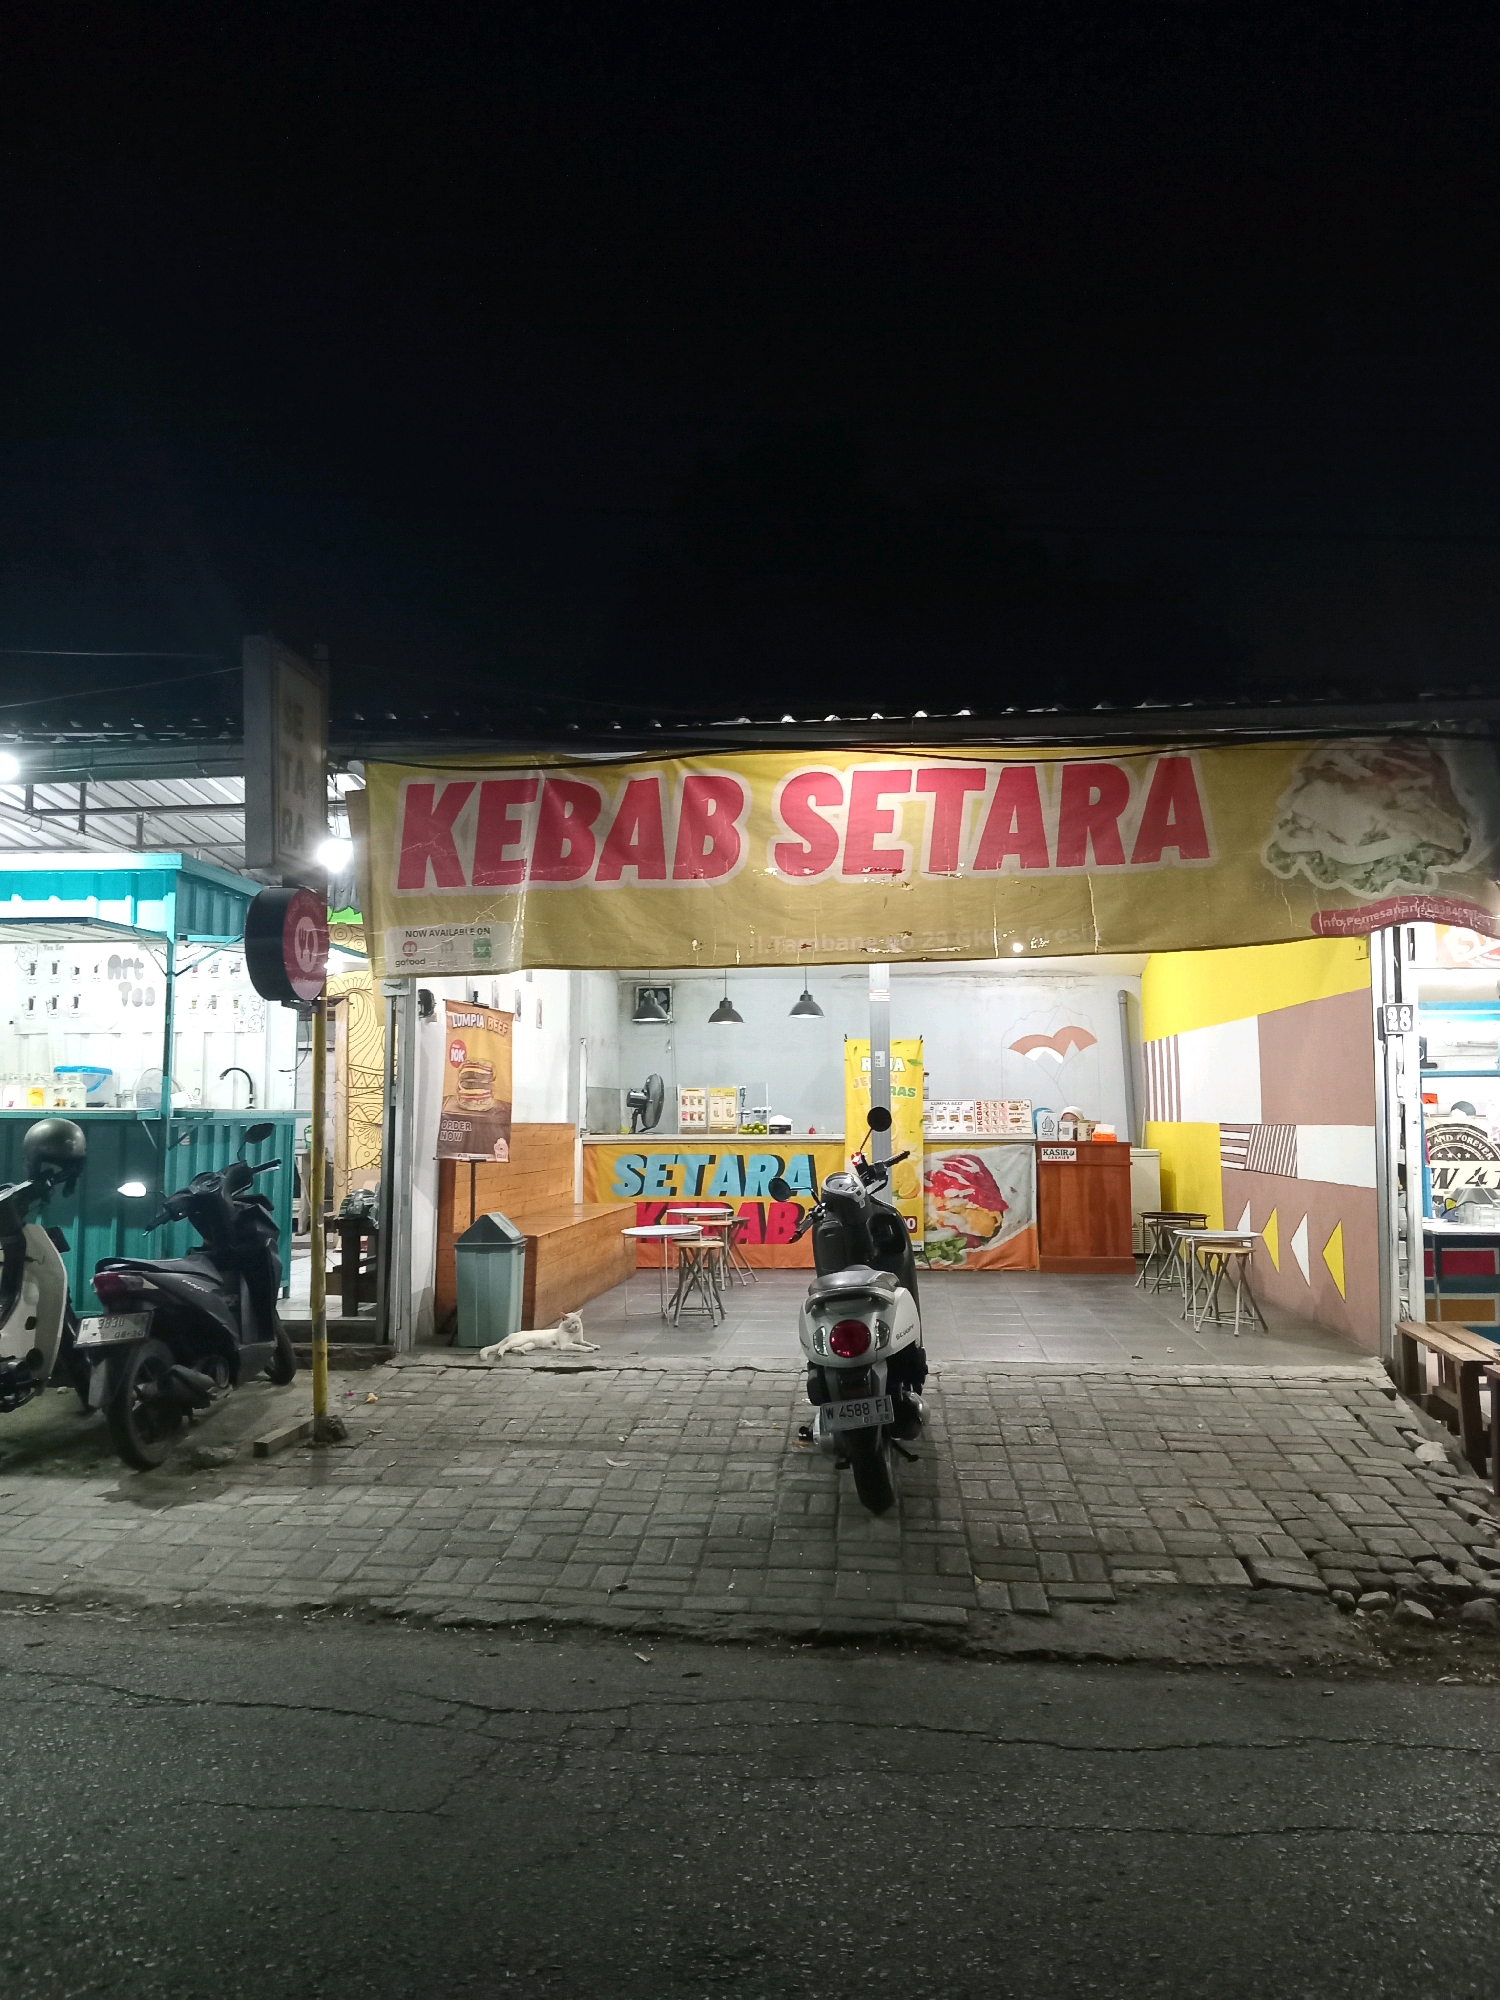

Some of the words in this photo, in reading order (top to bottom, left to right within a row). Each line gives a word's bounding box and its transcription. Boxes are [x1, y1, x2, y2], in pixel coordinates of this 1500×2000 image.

[397, 775, 745, 890] KEBAB
[774, 757, 1211, 876] SETARA
[405, 929, 428, 938] NOW
[477, 926, 491, 935] ON
[452, 1013, 485, 1029] LUMPIA
[487, 1016, 509, 1037] BEEF
[450, 1049, 466, 1062] 10K
[441, 1120, 472, 1131] ORDER
[440, 1131, 463, 1142] NOW
[611, 1154, 816, 1197] SETARA
[826, 1407, 834, 1420] W
[839, 1402, 870, 1418] 4588
[876, 1398, 888, 1414] FI
